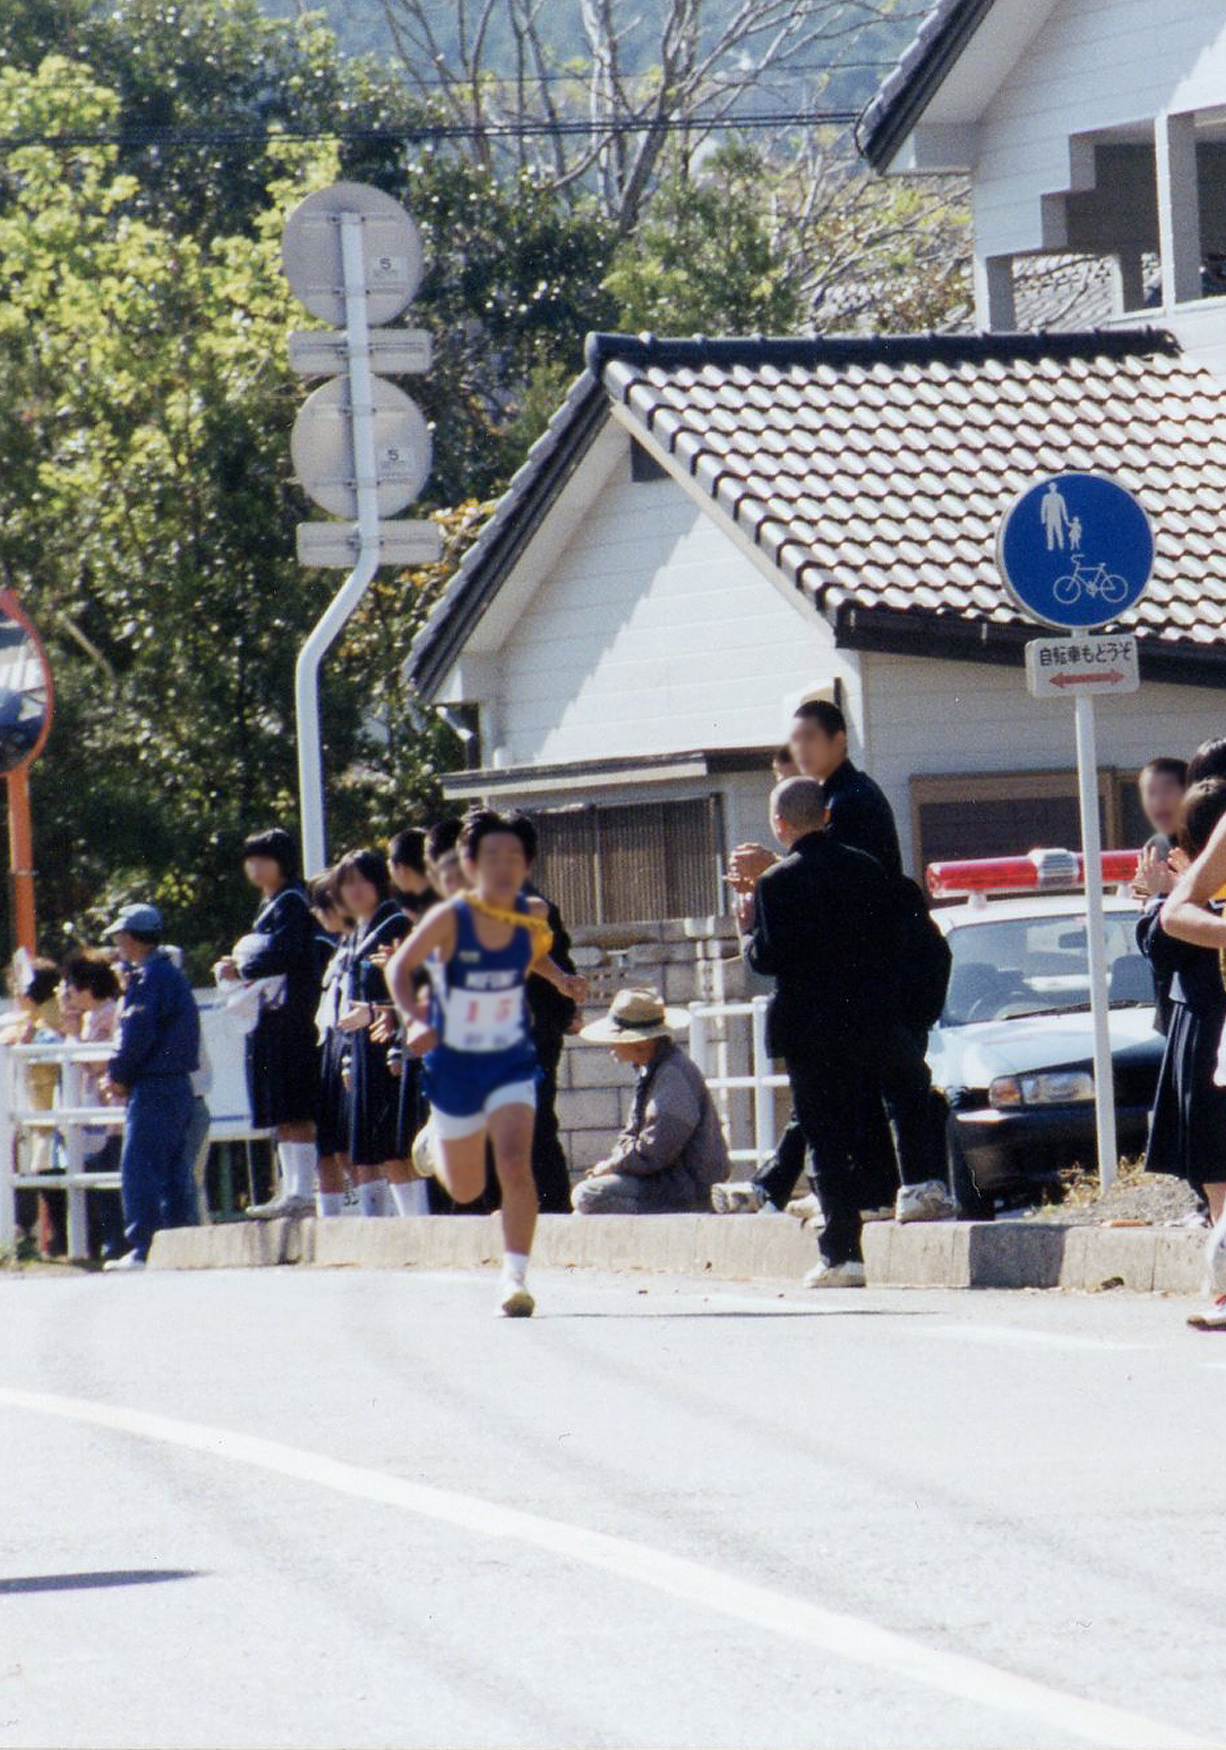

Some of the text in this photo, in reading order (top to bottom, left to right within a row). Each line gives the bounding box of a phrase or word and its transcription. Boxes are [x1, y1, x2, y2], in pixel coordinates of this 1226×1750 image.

[1040, 641, 1133, 667] 自転車もどうぞ
